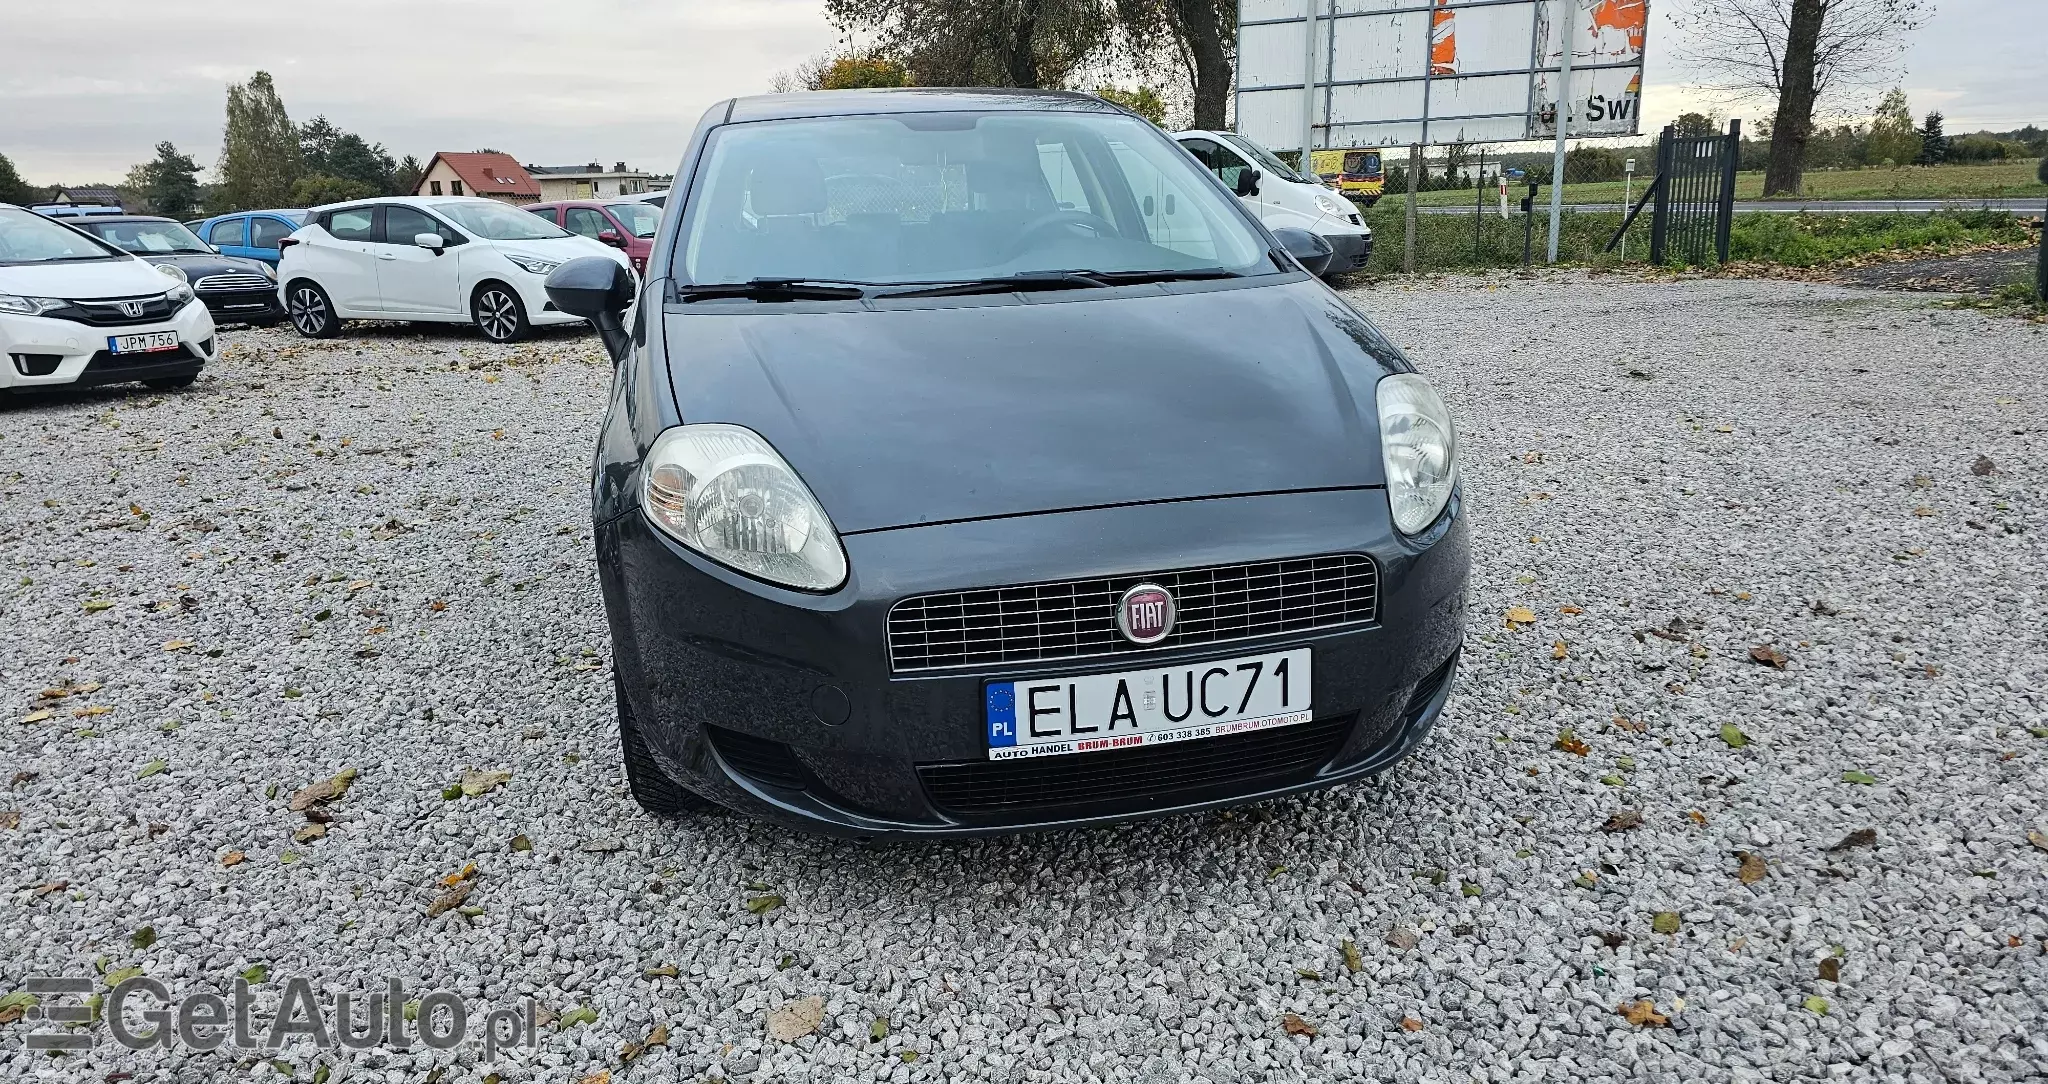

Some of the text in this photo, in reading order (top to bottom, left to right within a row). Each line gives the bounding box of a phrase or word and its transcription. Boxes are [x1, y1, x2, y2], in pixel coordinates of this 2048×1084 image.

[122, 334, 173, 349] JPM 756
[1131, 602, 1164, 630] FIAT
[1028, 657, 1289, 738] ELA UC71
[992, 722, 1013, 737] PL
[994, 750, 1028, 759] AUTO
[1031, 743, 1073, 755] HANDEL
[1077, 736, 1143, 751] BRUM-BRUM
[1157, 733, 1174, 742] 603
[1176, 730, 1193, 739] 338
[1215, 714, 1310, 734] BRUMBRUM.OTOMOTO.PL
